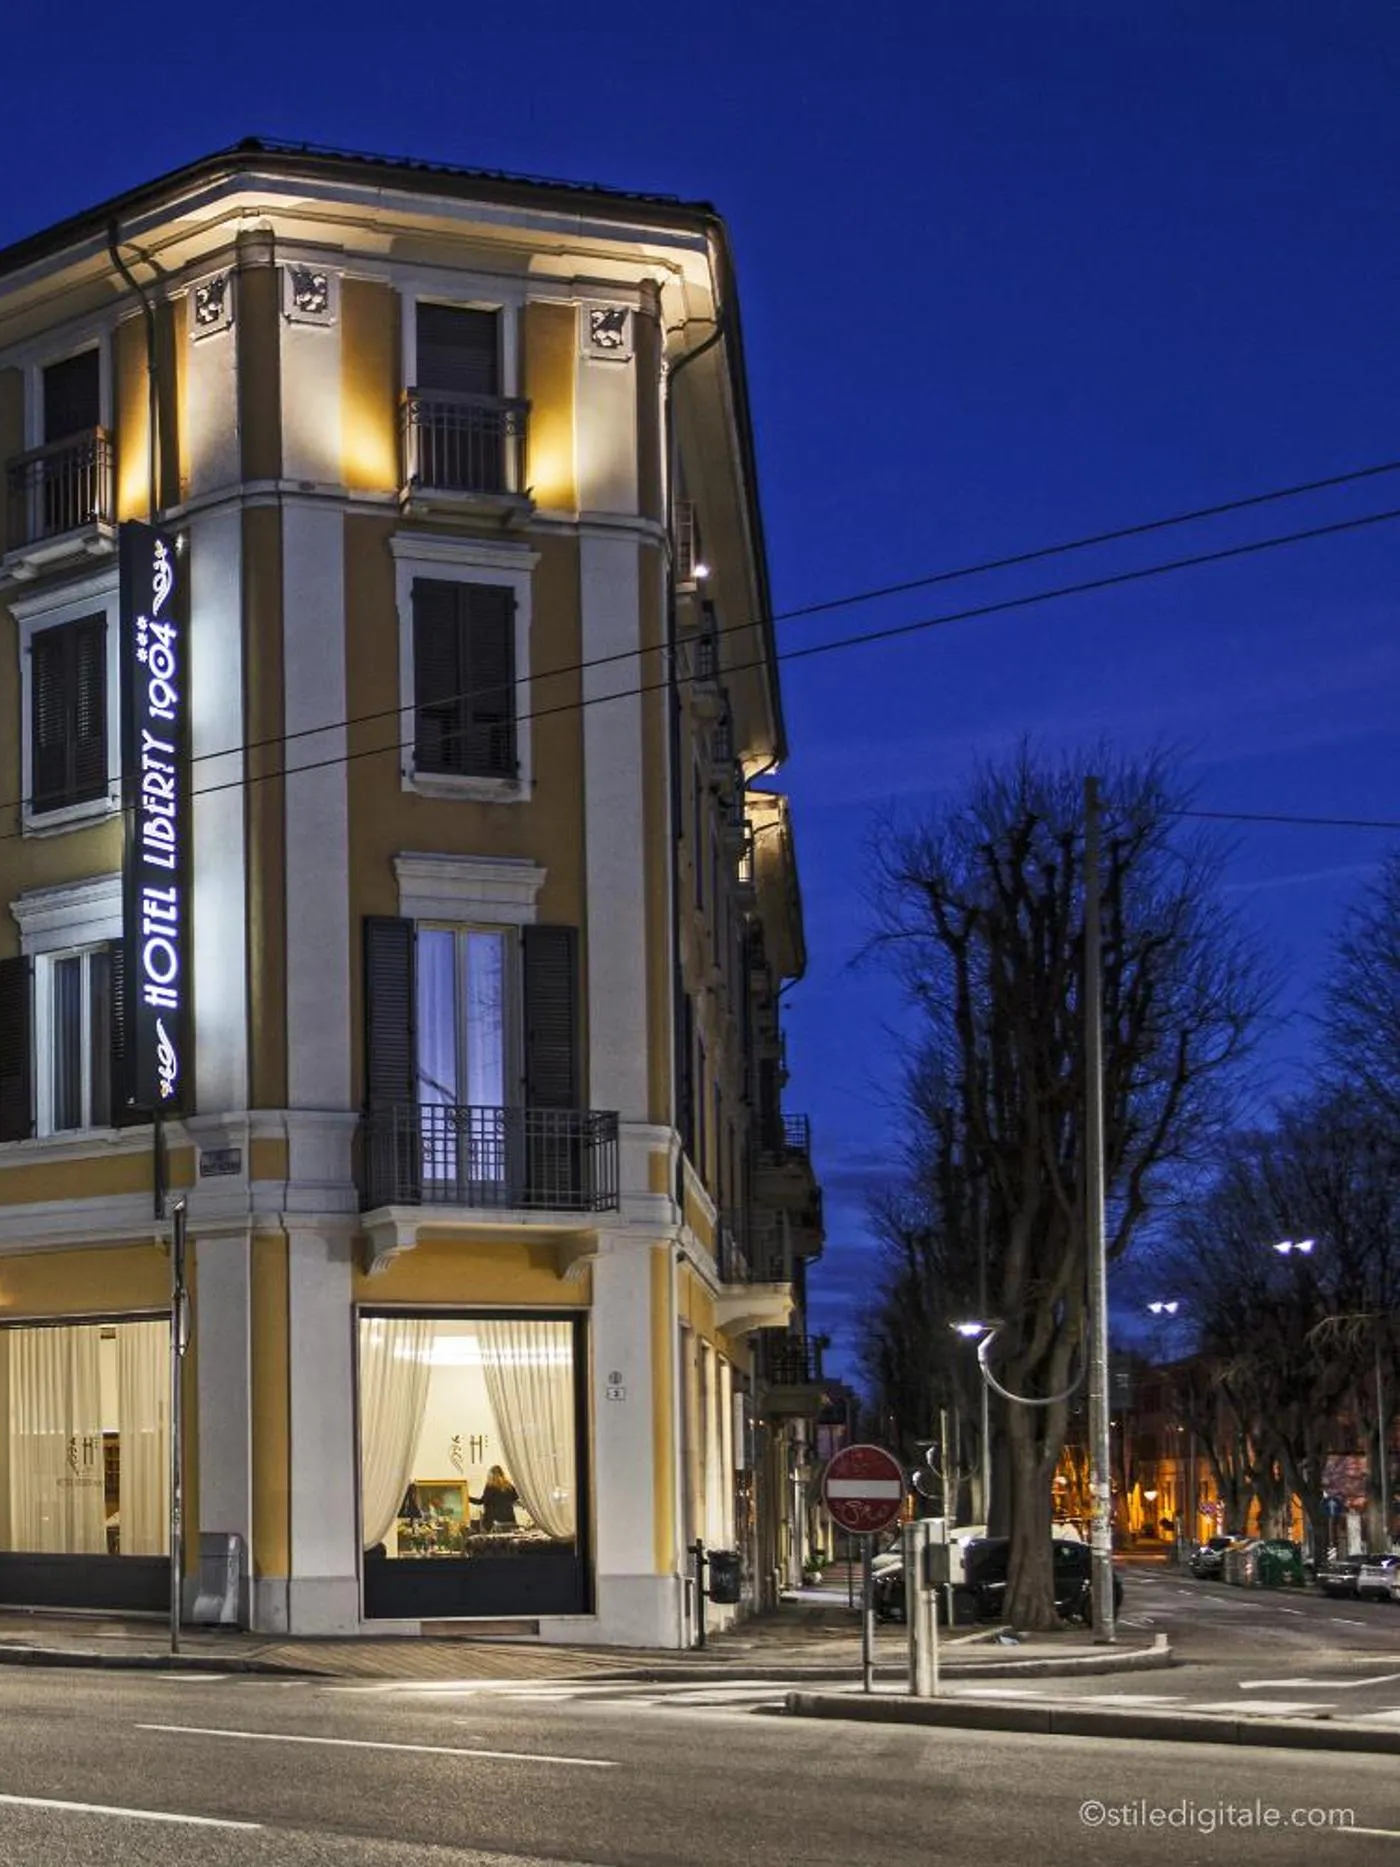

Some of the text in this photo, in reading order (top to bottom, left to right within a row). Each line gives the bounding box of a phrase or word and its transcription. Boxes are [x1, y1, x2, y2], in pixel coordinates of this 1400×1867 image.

[141, 622, 178, 1009] HOTEL LIBERTY 1904
